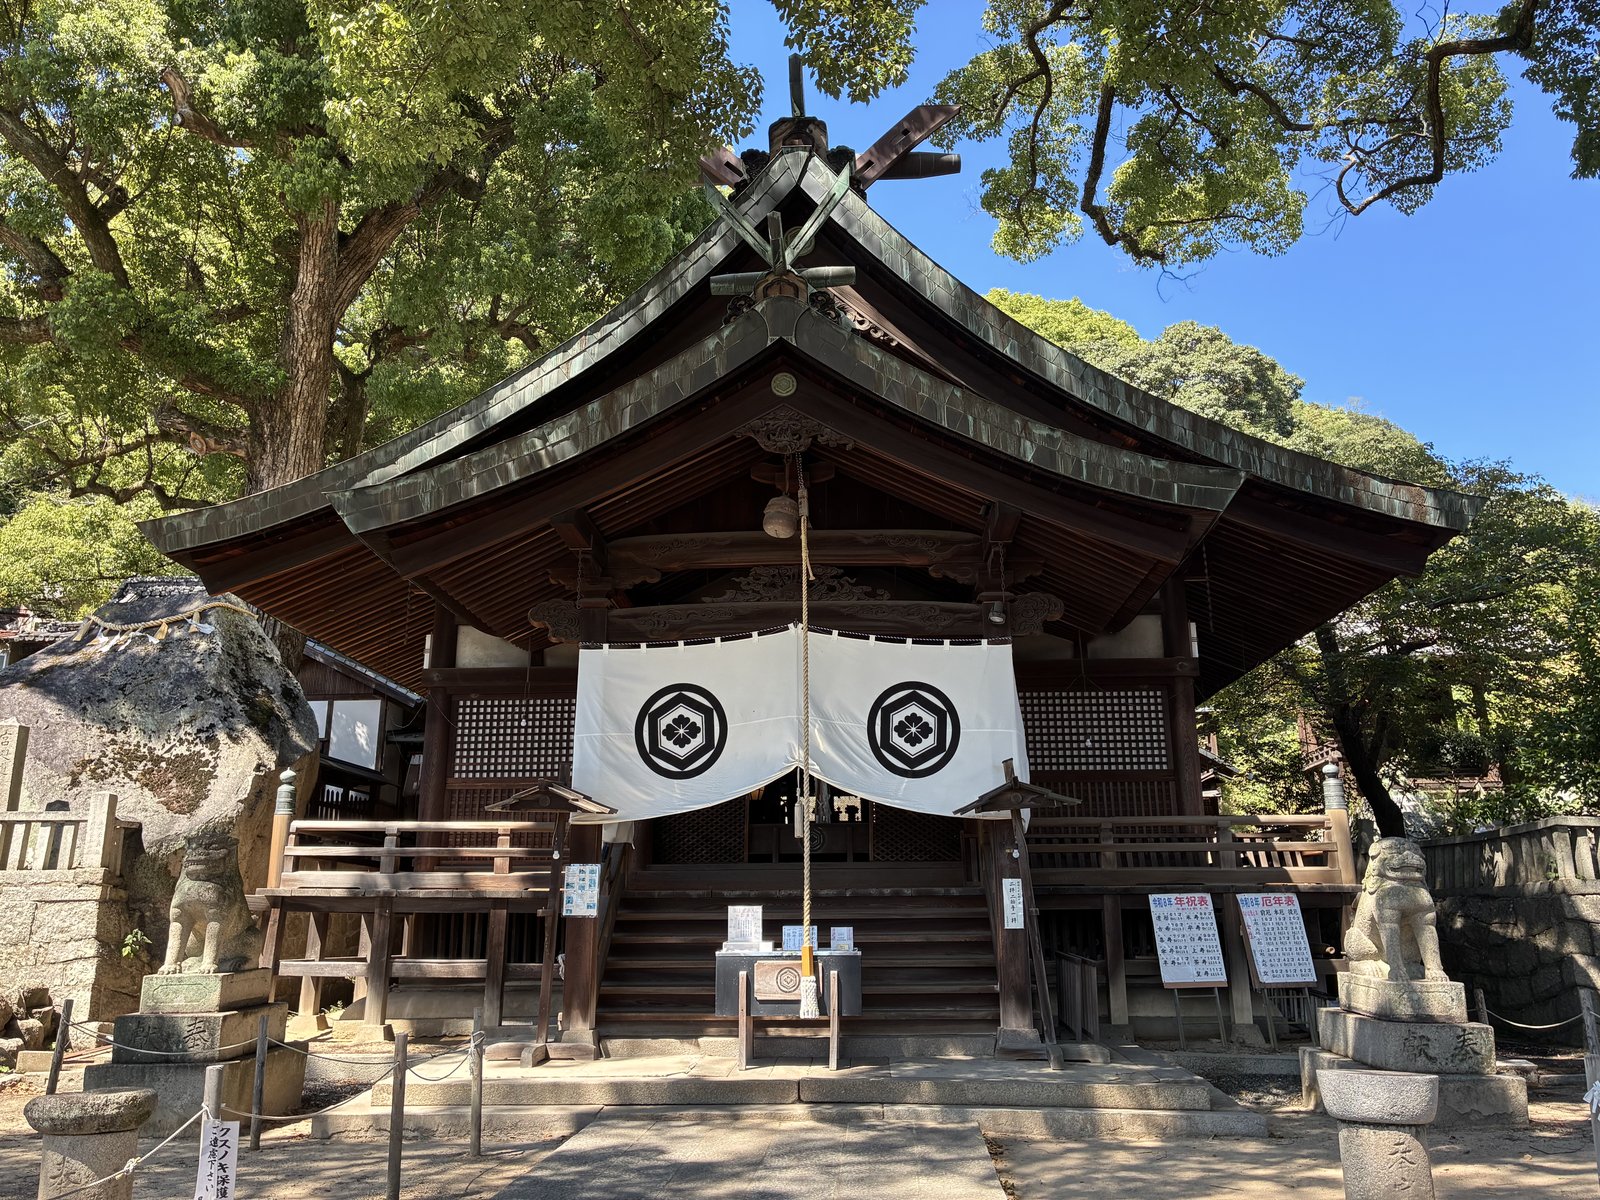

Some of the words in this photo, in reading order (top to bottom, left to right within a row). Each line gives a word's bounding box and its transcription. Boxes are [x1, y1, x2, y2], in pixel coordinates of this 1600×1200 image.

[1174, 895, 1209, 907] 年祝表
[1261, 895, 1296, 907] 厄年表
[205, 1125, 219, 1192] ご遠慮下さい
[216, 1127, 231, 1200] クスノキ保護
